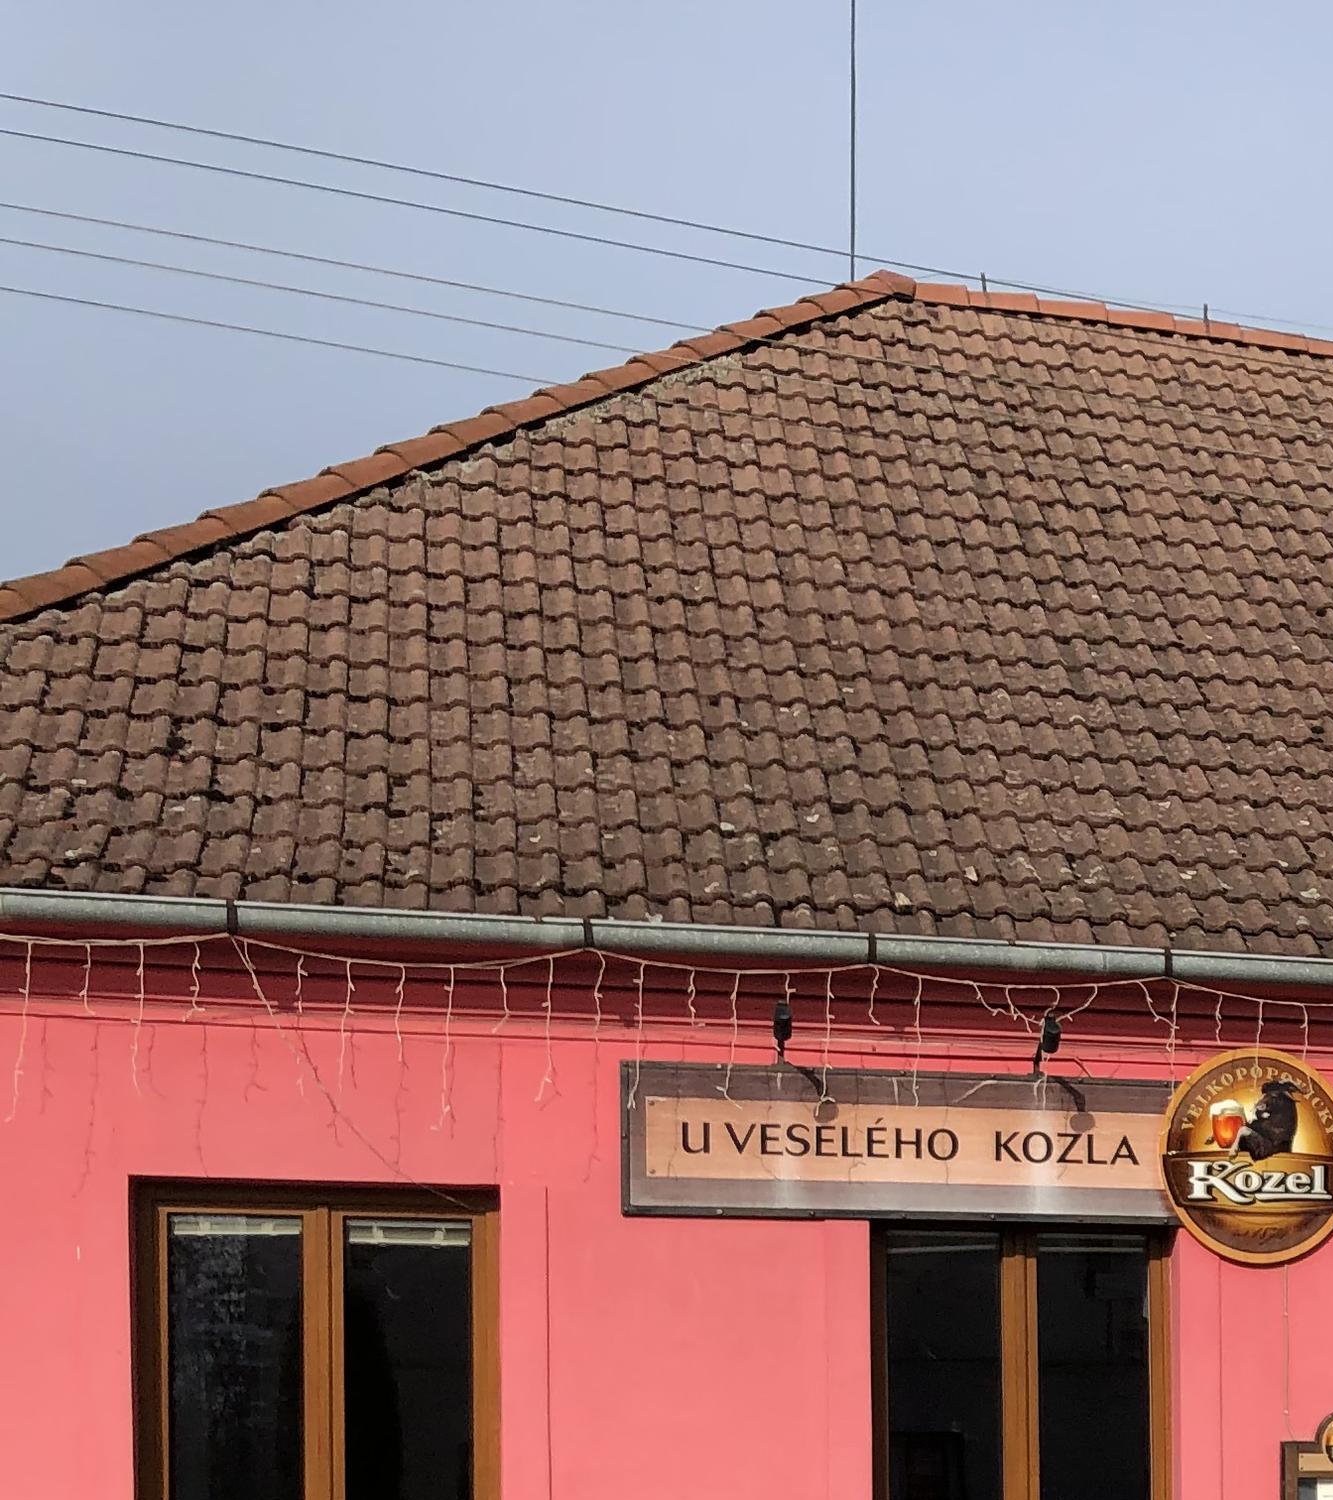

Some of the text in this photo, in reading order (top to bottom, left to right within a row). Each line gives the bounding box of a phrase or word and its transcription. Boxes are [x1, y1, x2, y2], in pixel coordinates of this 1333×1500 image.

[681, 1117, 1140, 1167] U VESELÉHO KOZLA
[1186, 1159, 1333, 1204] Kozel
